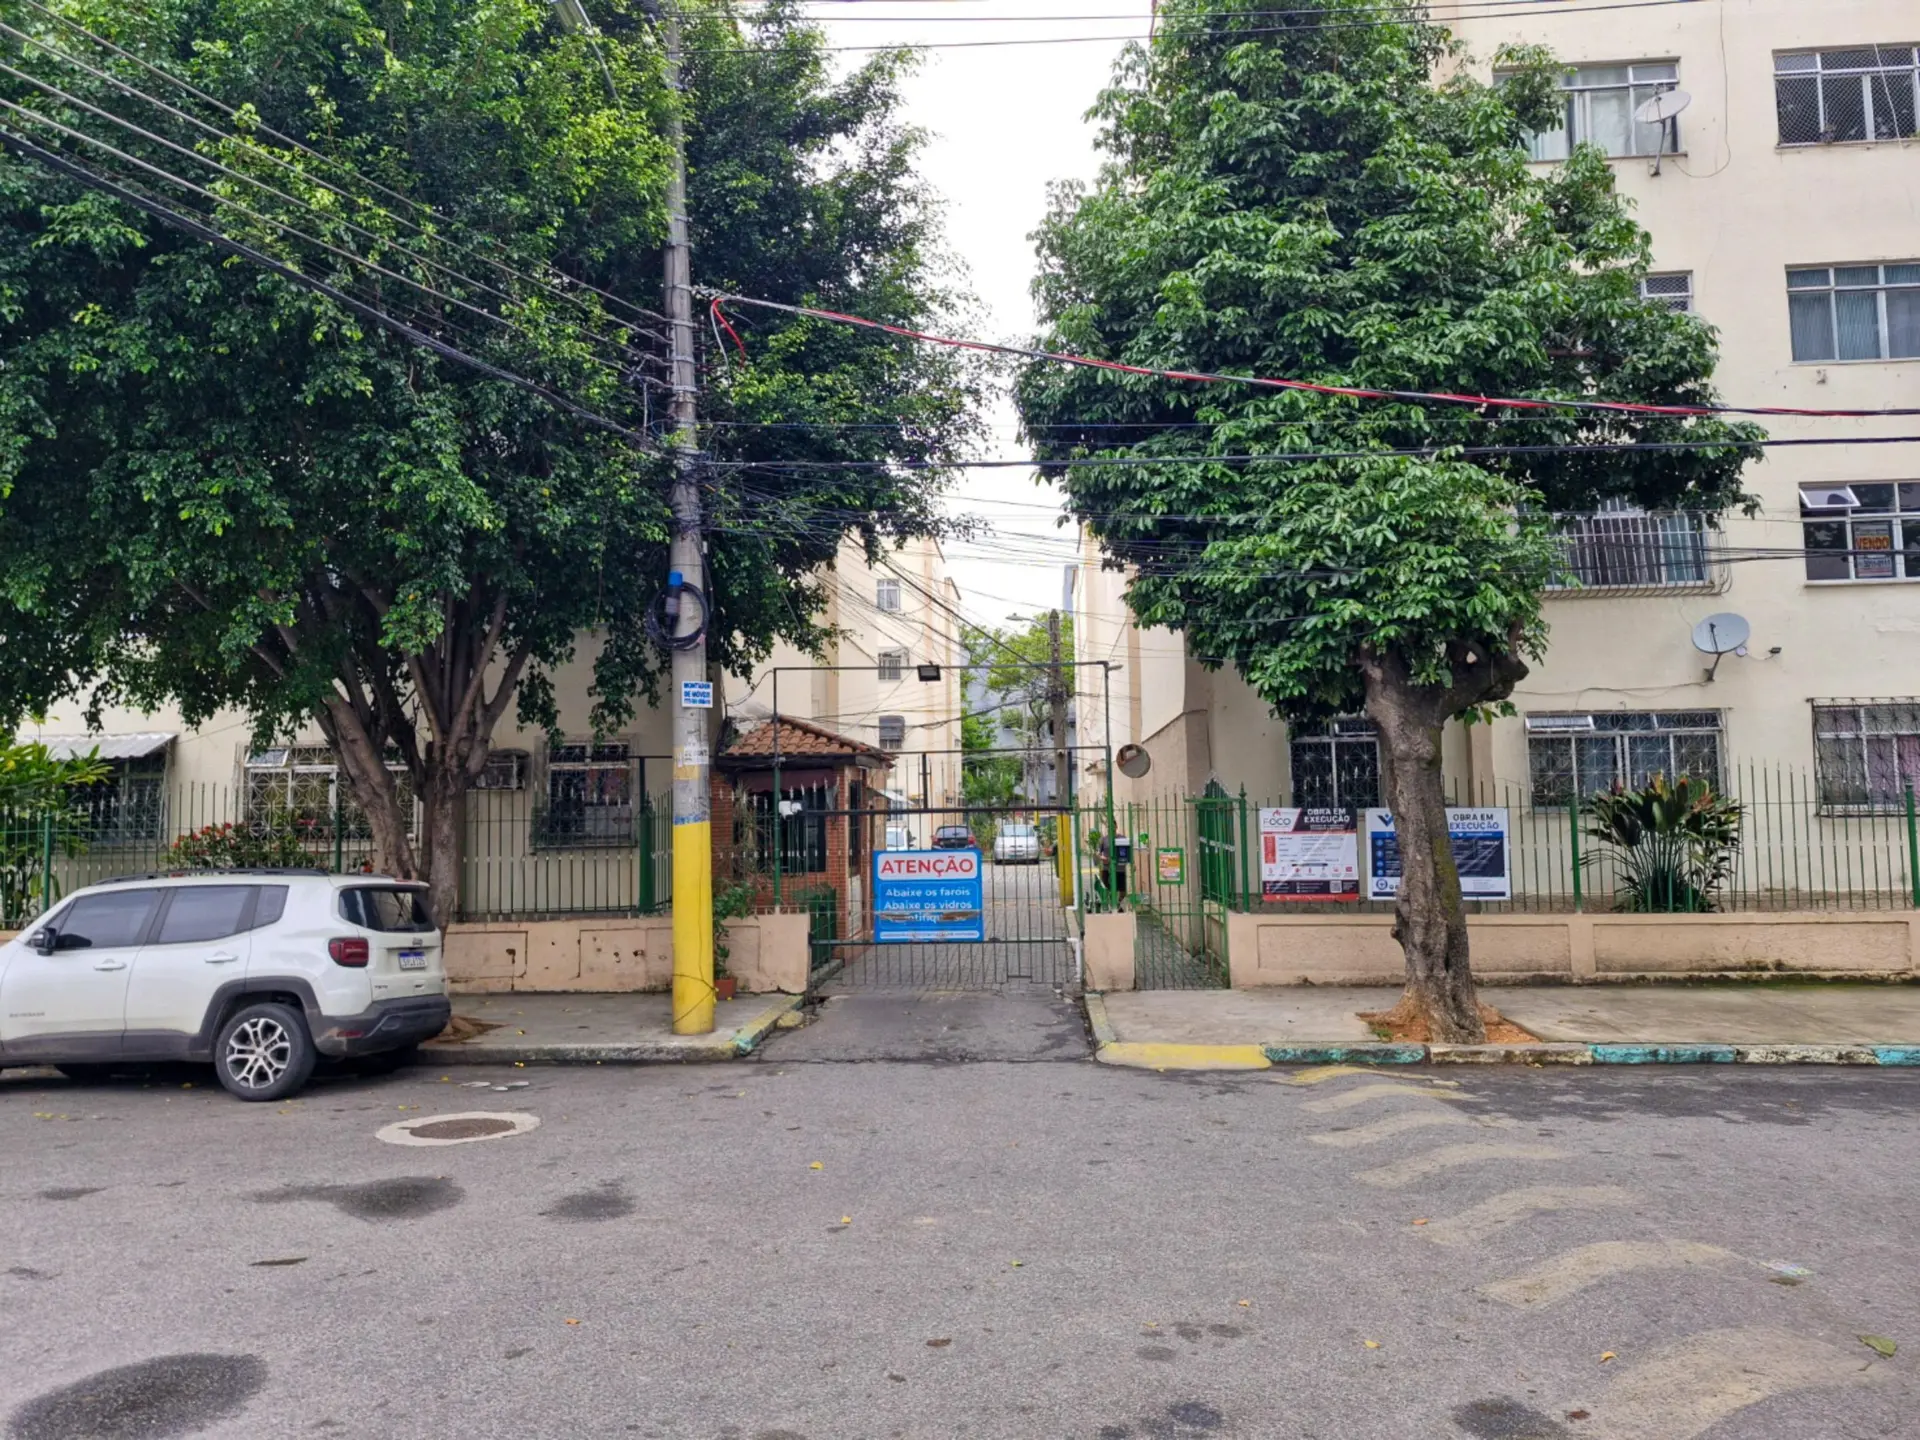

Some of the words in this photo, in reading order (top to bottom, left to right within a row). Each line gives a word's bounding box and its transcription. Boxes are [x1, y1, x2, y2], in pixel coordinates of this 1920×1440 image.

[1855, 536, 1889, 550] VENDO
[1333, 807, 1346, 815] EM
[1263, 817, 1291, 825] FOCO
[1303, 815, 1350, 824] EXECUÇÃO
[1452, 813, 1478, 821] OBRA
[1480, 813, 1494, 821] EM
[1449, 821, 1500, 830] EXECUÇÃO
[880, 856, 974, 877] ATENÇÃO
[885, 888, 922, 897] Abaixe
[925, 889, 937, 897] os
[884, 901, 920, 909] Abaixe
[939, 900, 972, 909] vidros
